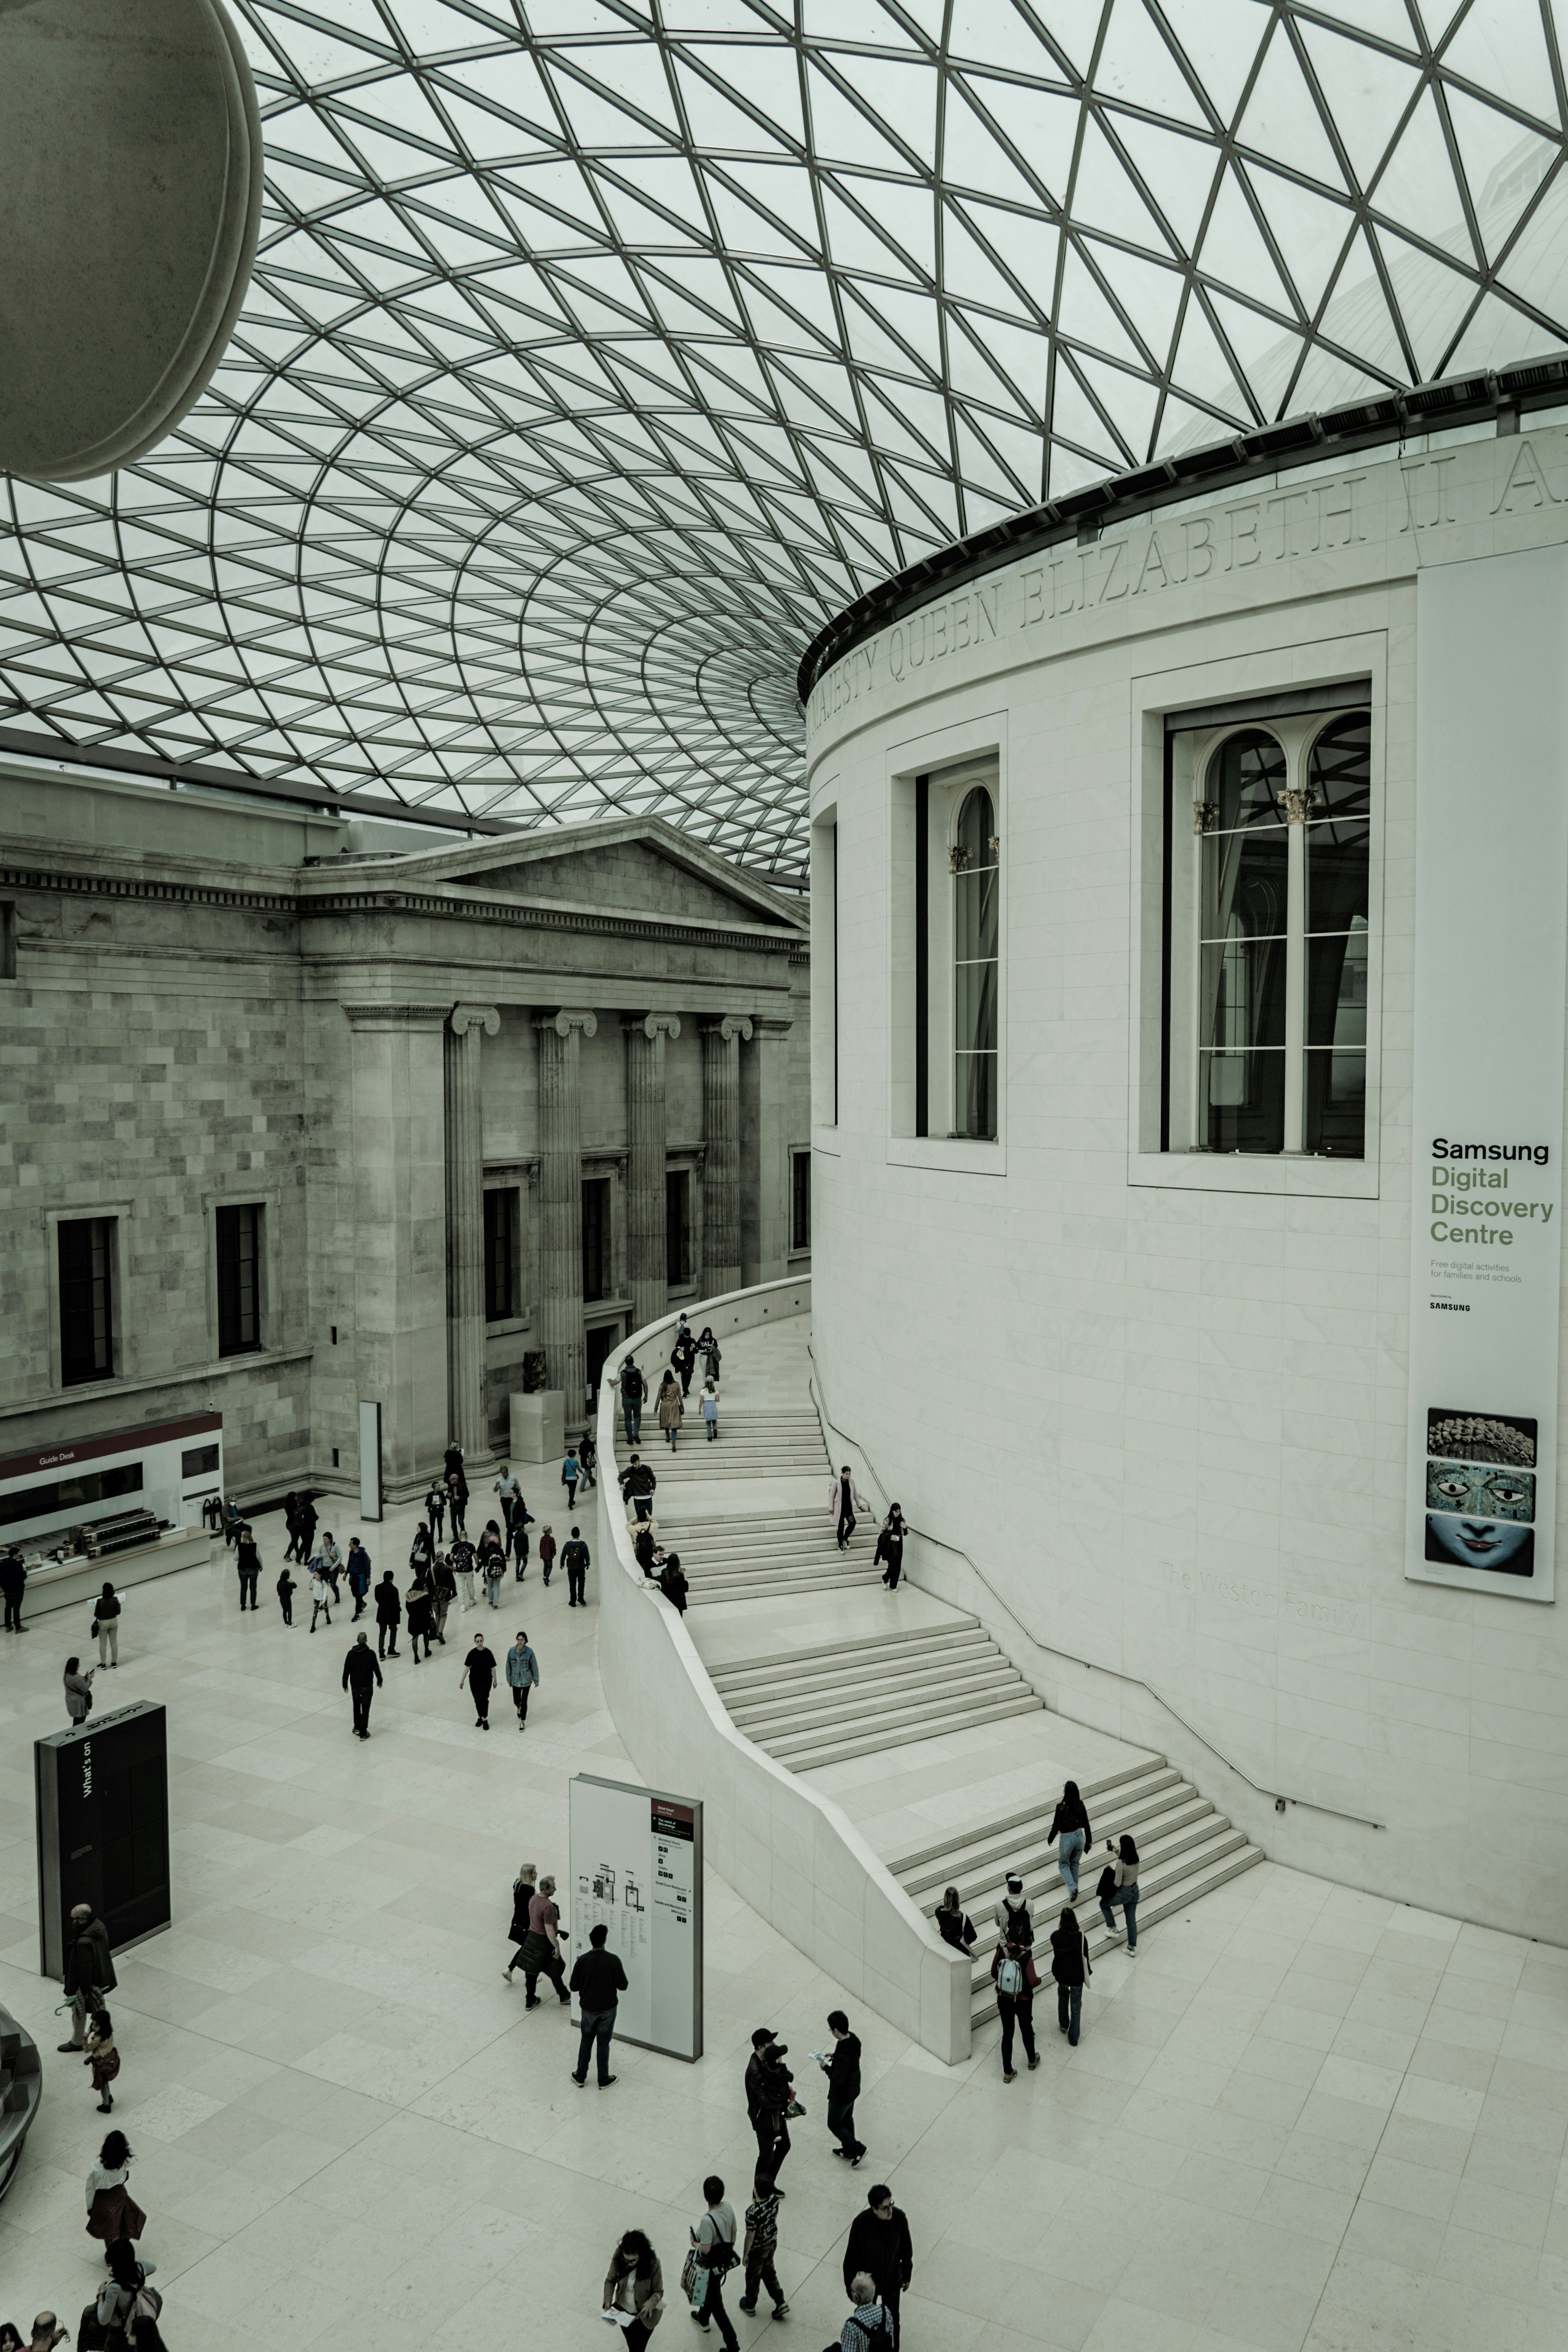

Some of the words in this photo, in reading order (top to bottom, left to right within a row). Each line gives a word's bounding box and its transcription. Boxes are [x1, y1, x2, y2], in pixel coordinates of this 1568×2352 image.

[890, 583, 1003, 683] QUEEN
[1020, 477, 1366, 628] ELIZABETH
[1400, 456, 1456, 533] II
[1490, 434, 1568, 515] A
[1431, 1138, 1549, 1165] Samsung
[1432, 1166, 1508, 1192] Digital
[1431, 1194, 1554, 1223] Discovery
[1431, 1221, 1513, 1245] Centre
[1431, 1259, 1448, 1268] Free
[1450, 1261, 1473, 1271] digital
[1475, 1263, 1509, 1272] activities
[1444, 1270, 1473, 1279] families
[1492, 1274, 1522, 1283] schools
[1430, 1302, 1470, 1312] SAMSUNG
[39, 1456, 59, 1465] Guide
[59, 1451, 75, 1461] Desk
[1158, 1561, 1191, 1590] The
[1199, 1571, 1274, 1610] Weston
[1285, 1591, 1359, 1634] Family
[84, 1741, 91, 1756] on
[82, 1758, 92, 1798] What's
